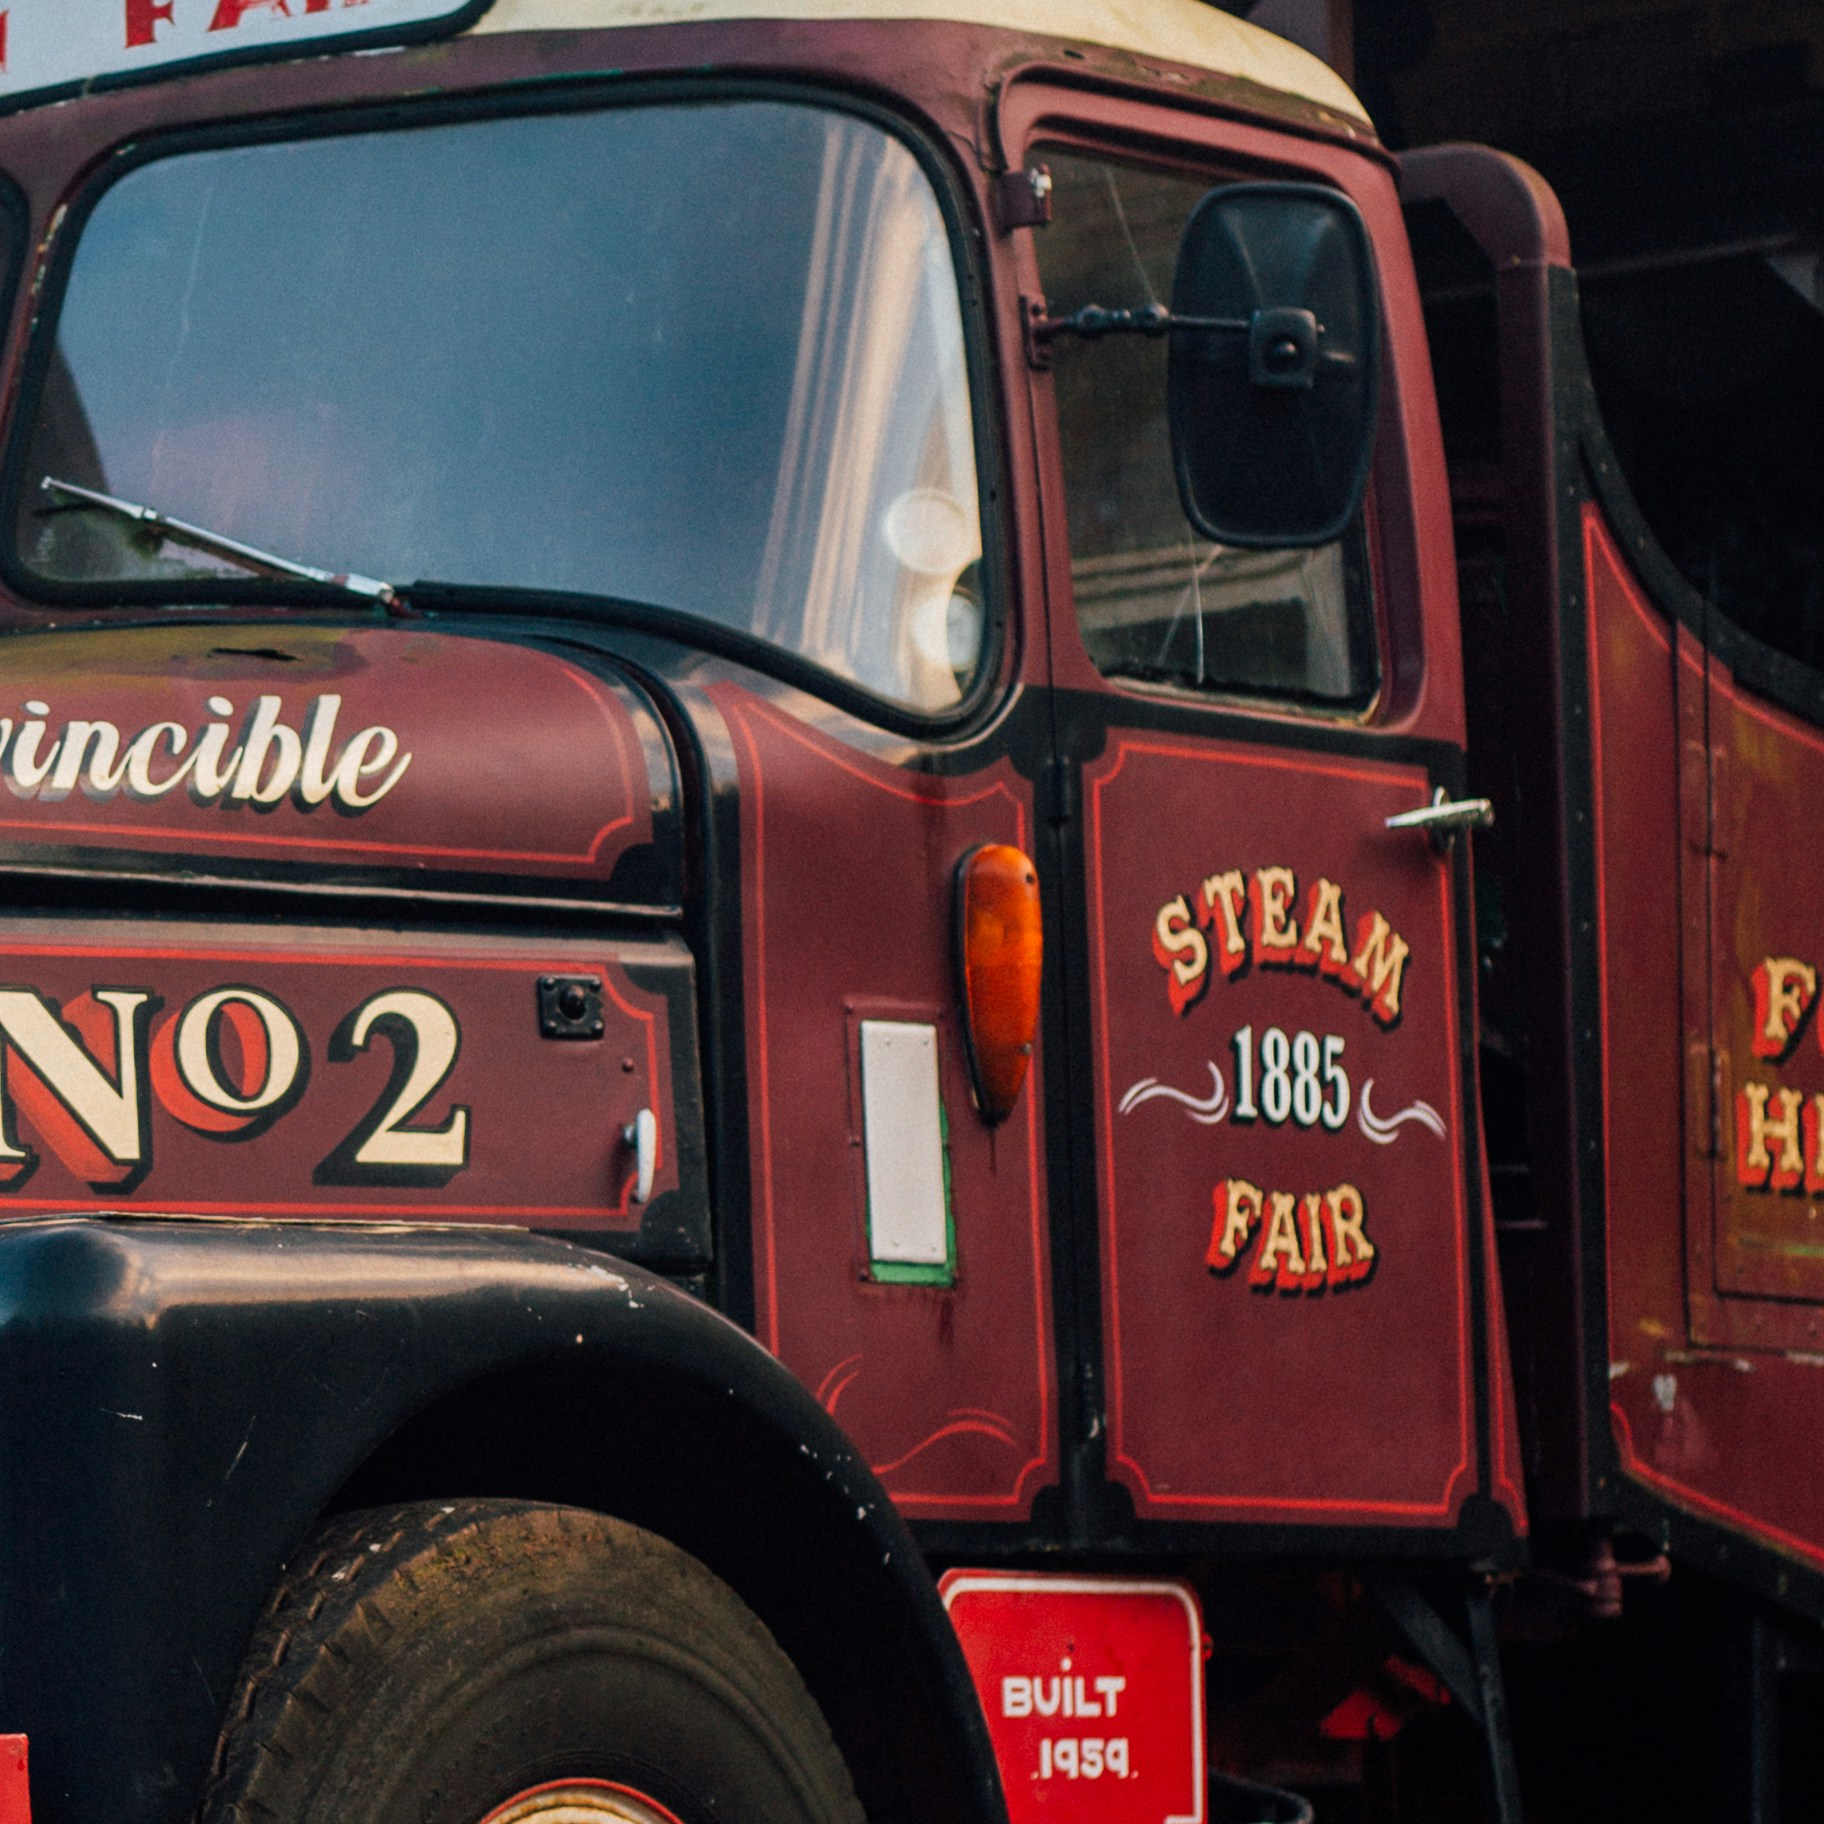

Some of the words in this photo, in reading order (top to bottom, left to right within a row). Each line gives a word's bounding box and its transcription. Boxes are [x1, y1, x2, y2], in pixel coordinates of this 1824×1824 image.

[1154, 865, 1410, 1018] STEAM
[348, 987, 471, 1169] 2
[1234, 1024, 1352, 1130] 1885
[1214, 1178, 1376, 1277] FAIR
